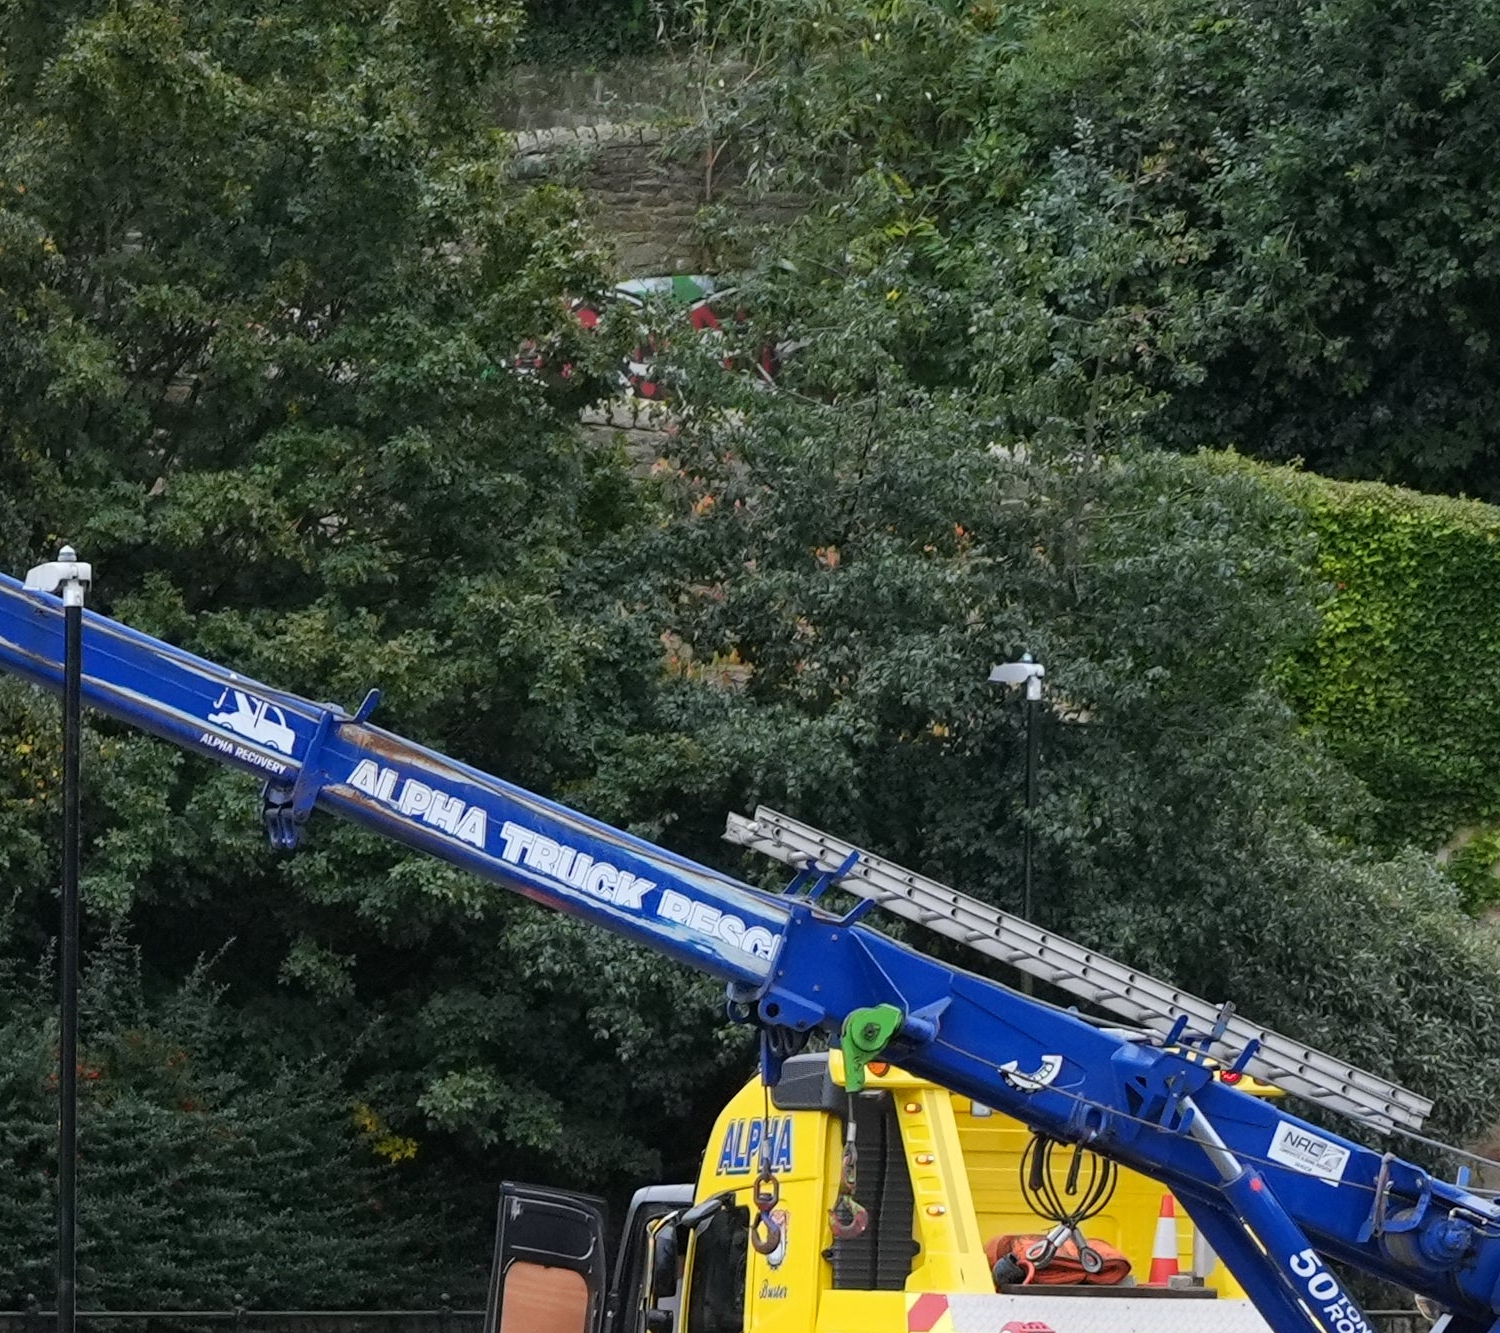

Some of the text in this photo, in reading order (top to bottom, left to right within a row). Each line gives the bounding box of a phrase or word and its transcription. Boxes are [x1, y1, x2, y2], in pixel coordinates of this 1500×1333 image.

[200, 732, 287, 774] ALPHA RECOVERY
[345, 758, 487, 849] ALPHA
[500, 821, 657, 910] TRUCK
[716, 1116, 795, 1176] ALPHA
[1284, 1131, 1324, 1157] NRC
[1289, 1248, 1339, 1300] 50
